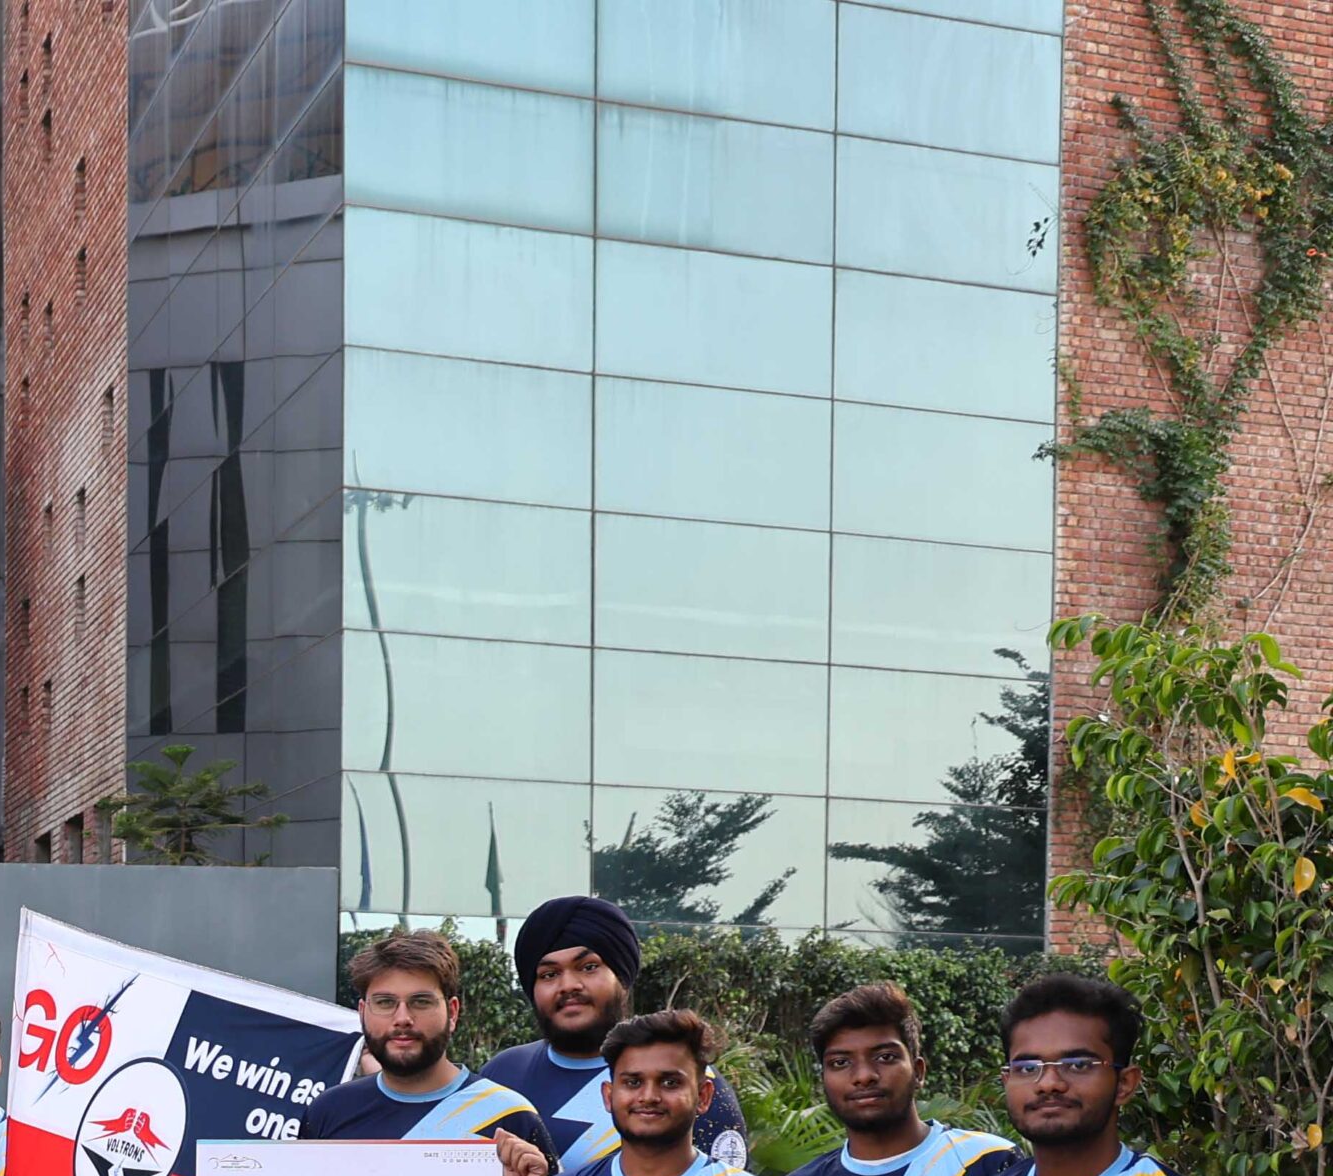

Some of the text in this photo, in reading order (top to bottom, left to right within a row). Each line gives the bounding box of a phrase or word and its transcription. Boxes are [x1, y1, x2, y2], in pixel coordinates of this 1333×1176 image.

[18, 989, 112, 1085] GO
[183, 1036, 325, 1106] We win as
[106, 1137, 145, 1162] VOLTRONS
[245, 1108, 300, 1140] one
